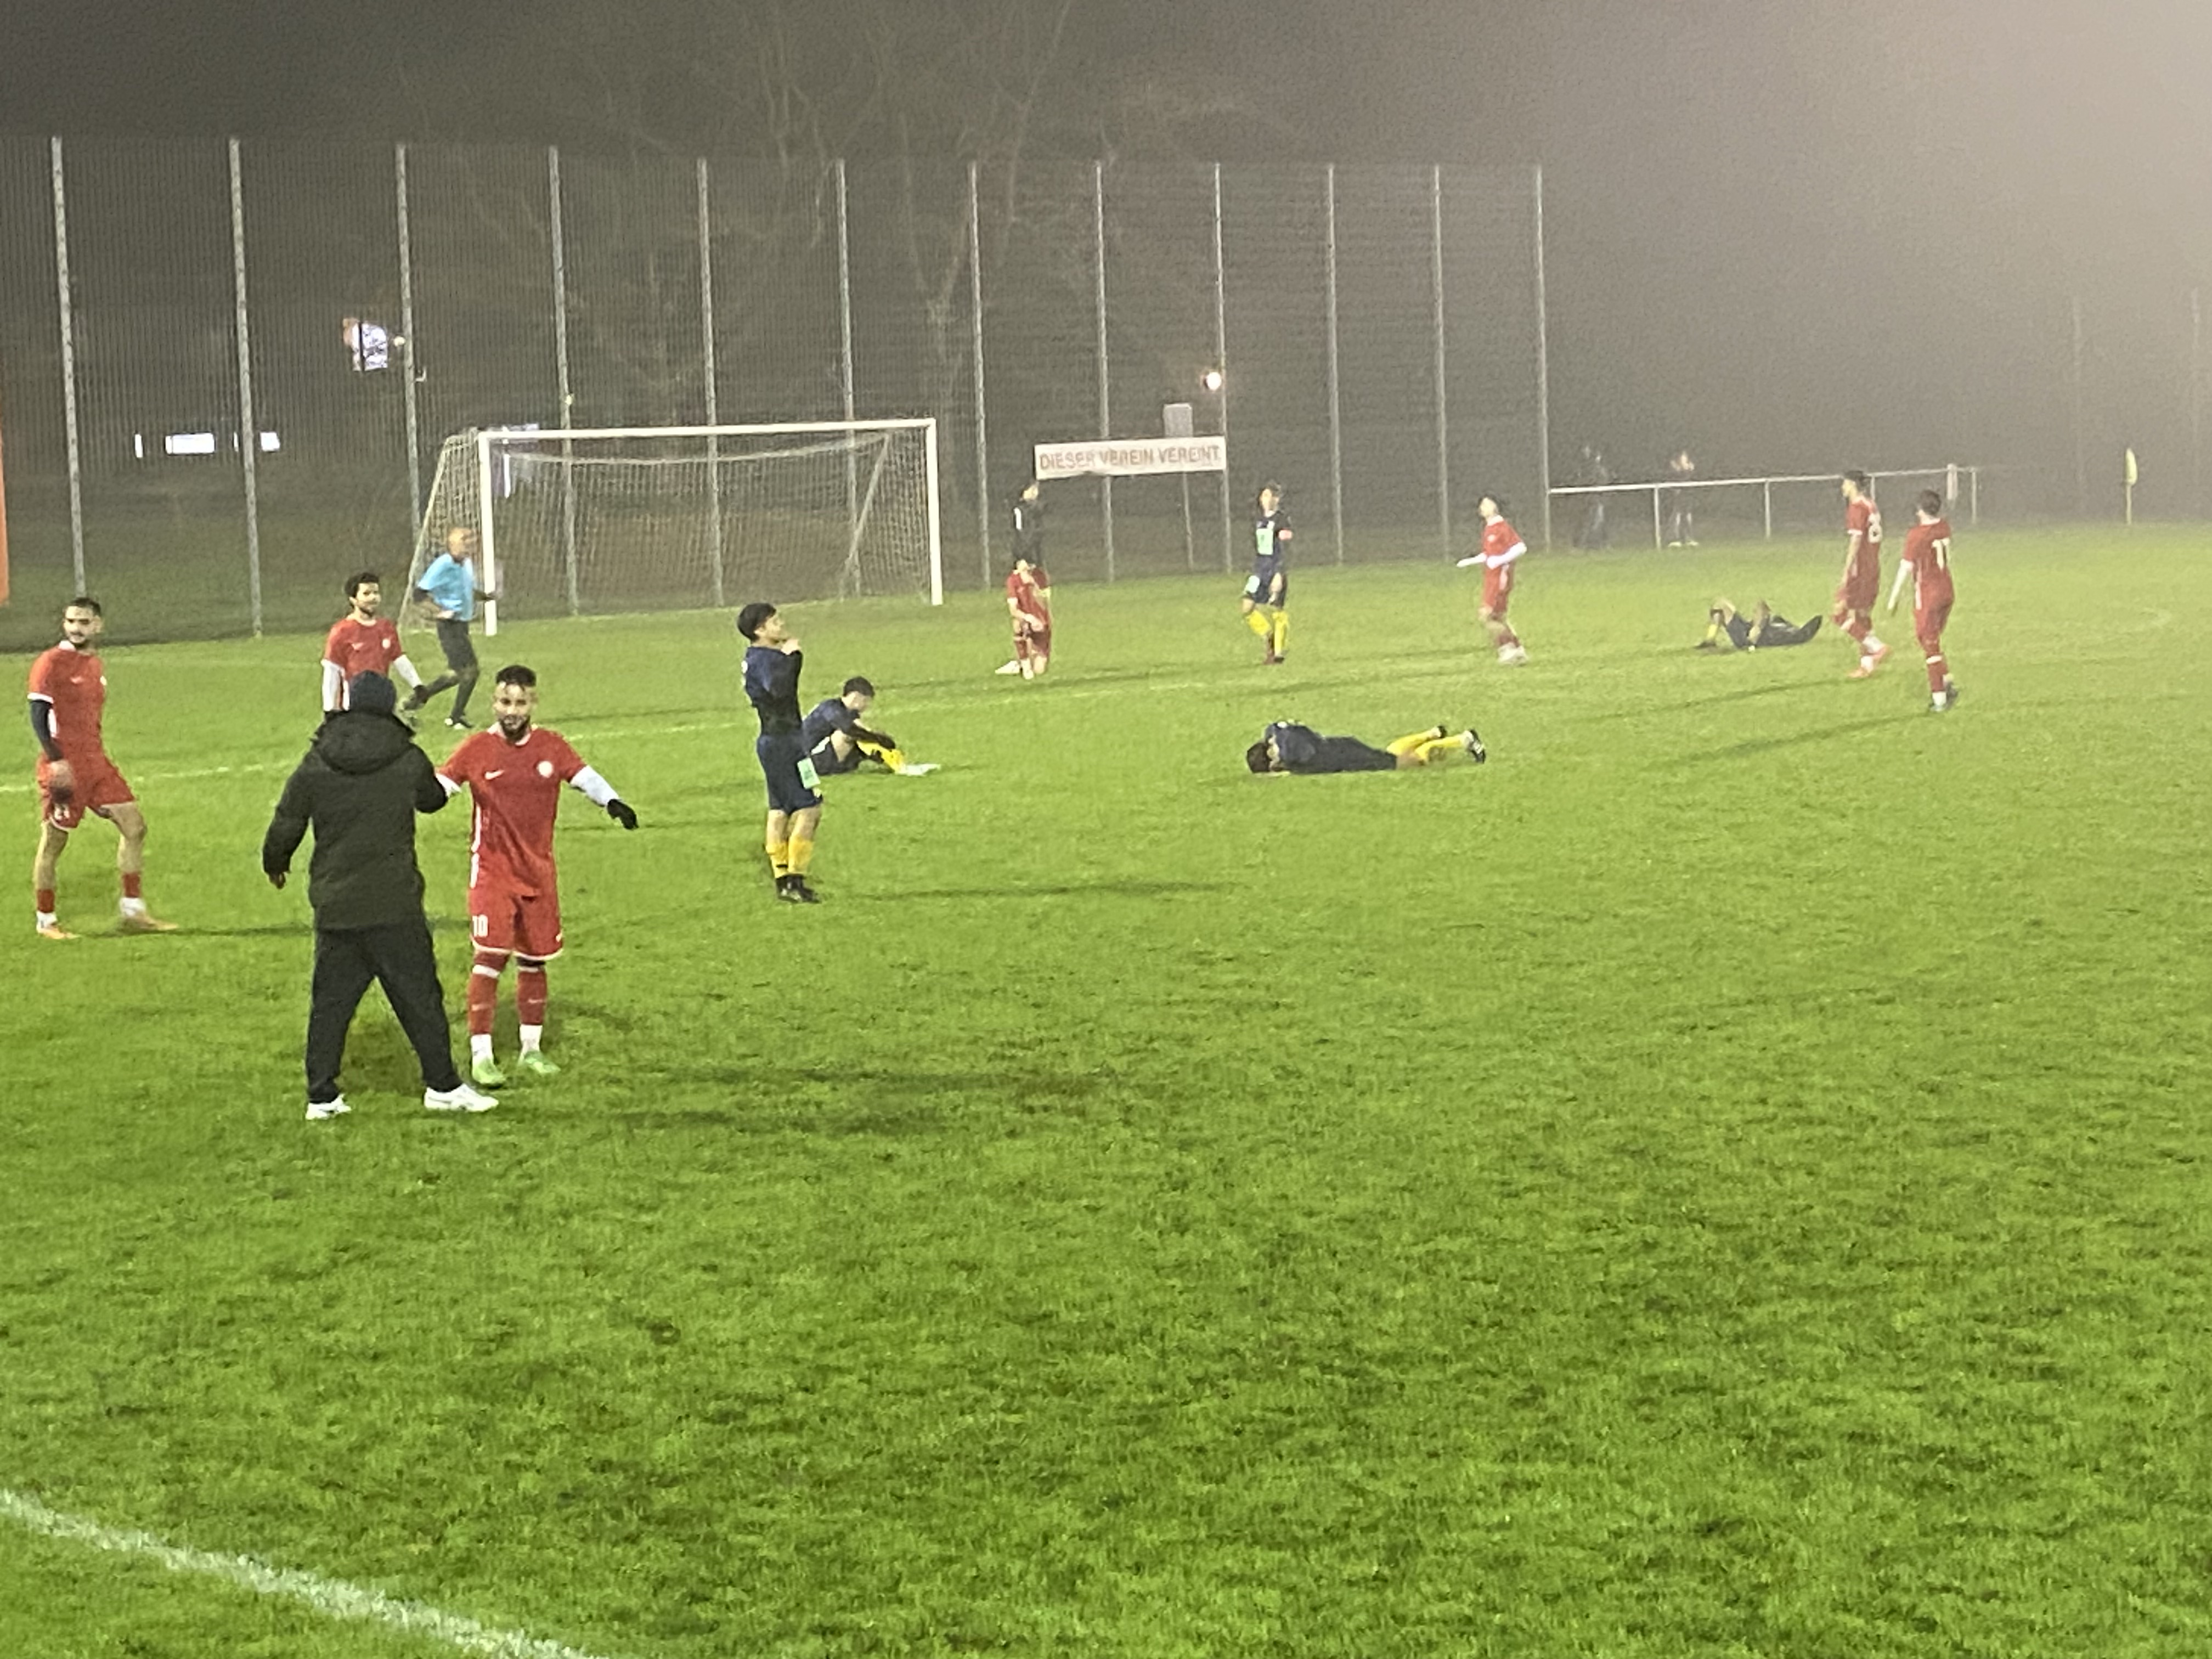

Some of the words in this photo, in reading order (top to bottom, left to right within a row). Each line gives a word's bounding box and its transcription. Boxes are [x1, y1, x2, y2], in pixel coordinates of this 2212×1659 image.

[1039, 450, 1095, 470] DIESER
[1099, 448, 1154, 466] VEREIN
[472, 914, 488, 937] 10
